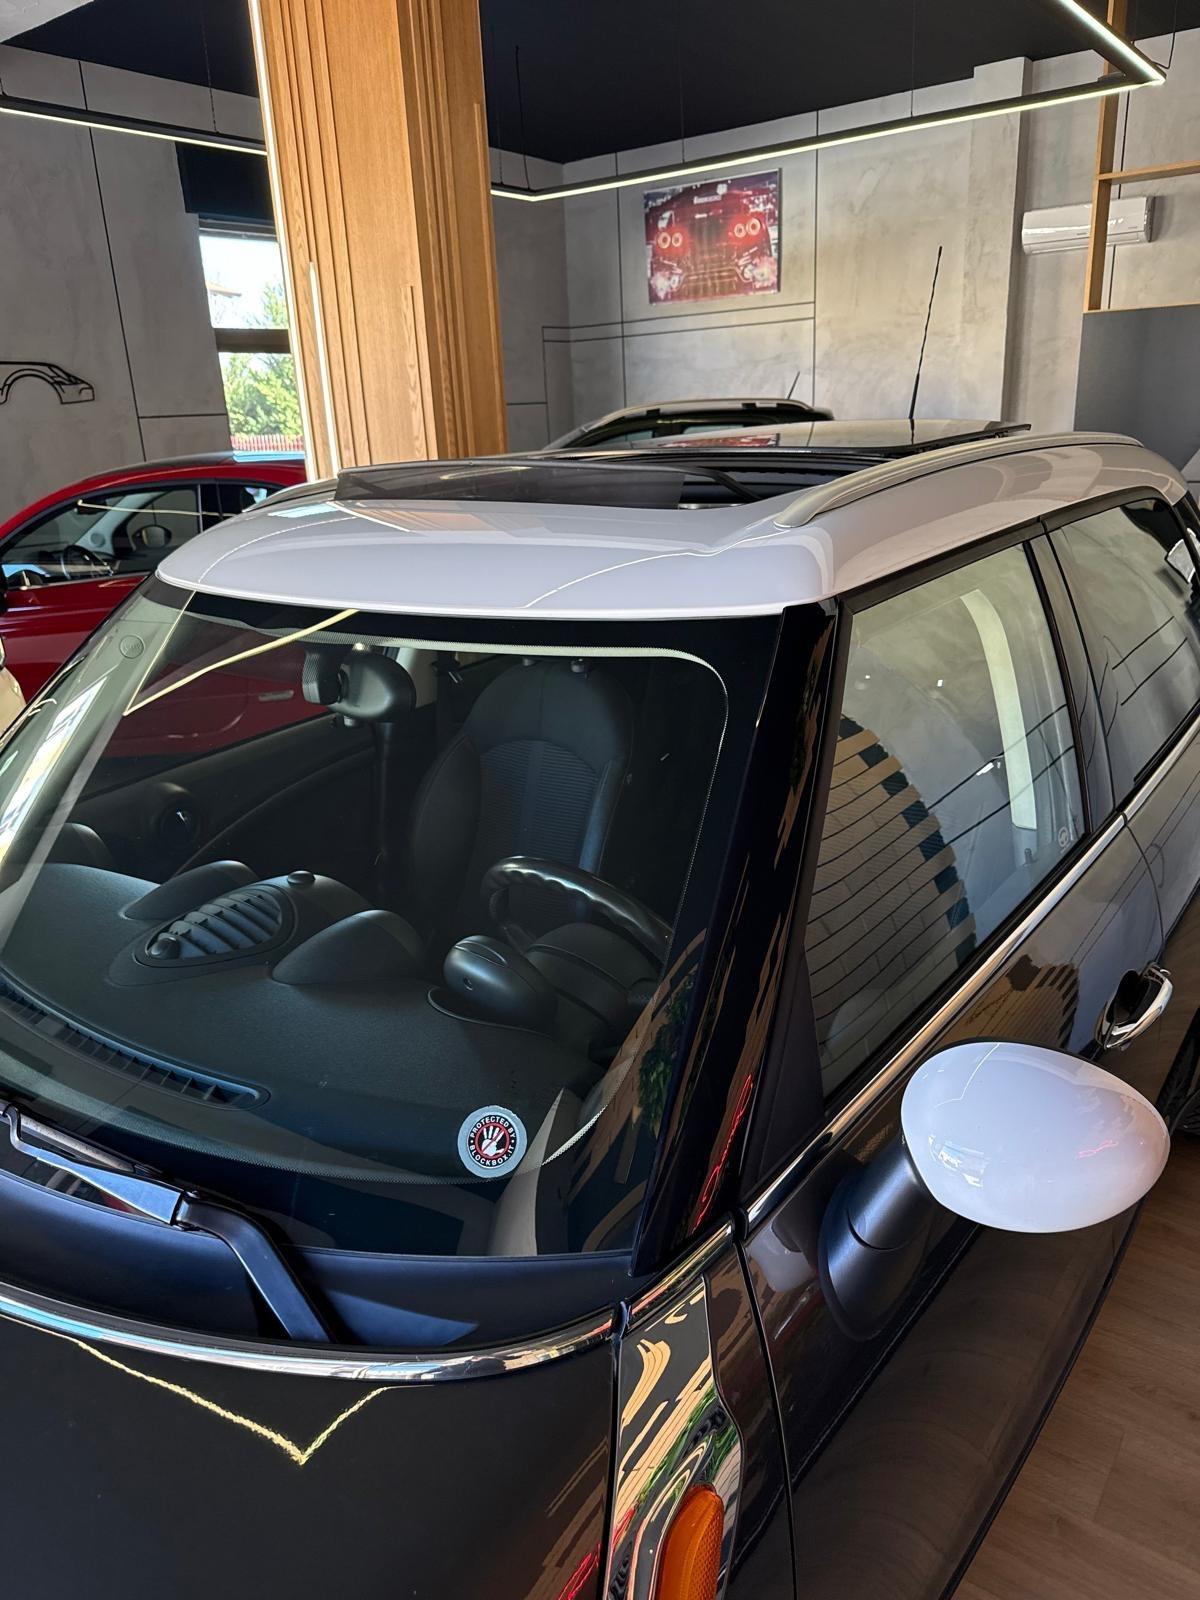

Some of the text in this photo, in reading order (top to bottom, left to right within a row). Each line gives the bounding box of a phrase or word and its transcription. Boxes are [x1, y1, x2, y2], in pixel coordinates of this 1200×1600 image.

[470, 1116, 516, 1137] PROTECTED BY
[469, 1145, 514, 1166] BLOCKBOX.IT
